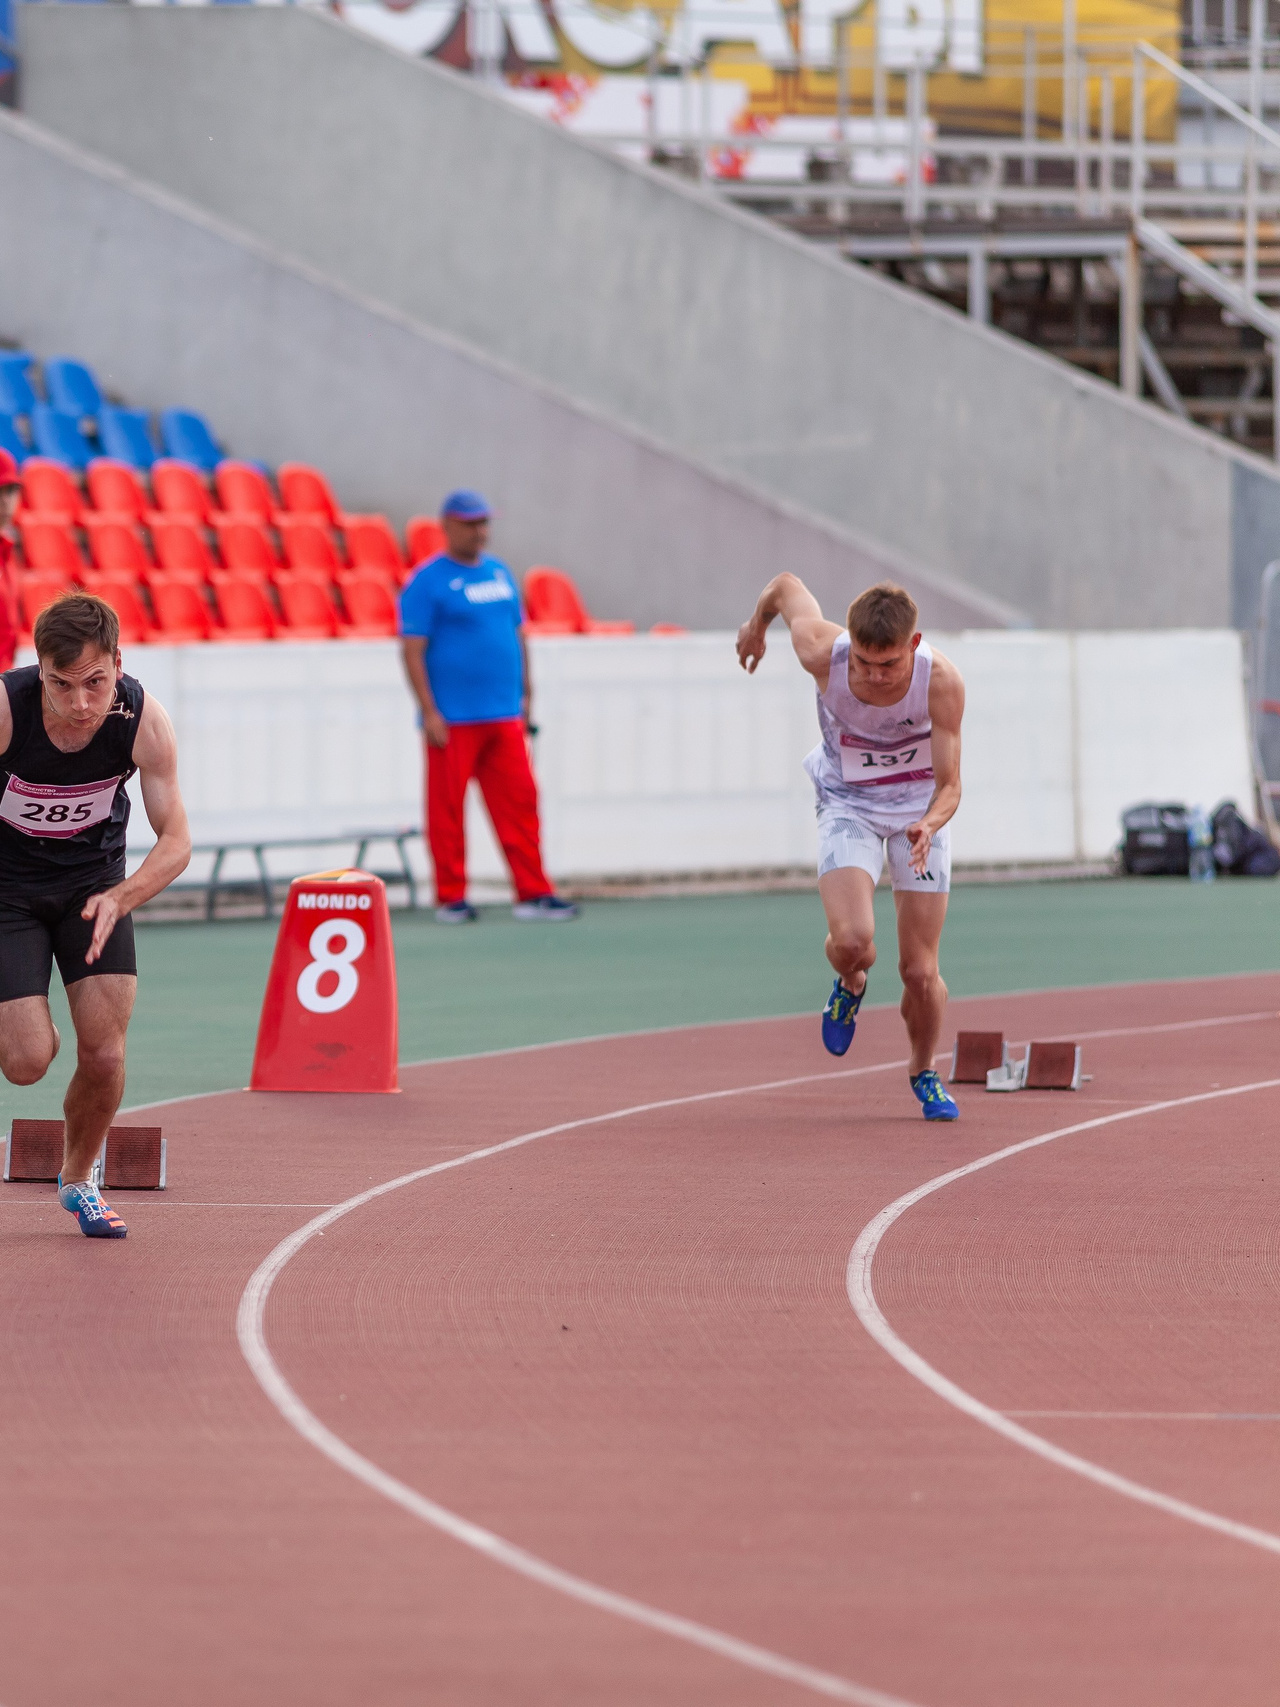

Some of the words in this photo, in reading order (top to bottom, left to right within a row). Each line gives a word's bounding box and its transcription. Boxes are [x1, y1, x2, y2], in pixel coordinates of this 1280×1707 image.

[859, 747, 918, 768] 137
[19, 801, 95, 823] 285
[297, 893, 372, 911] MONDO
[296, 917, 366, 1014] 8
